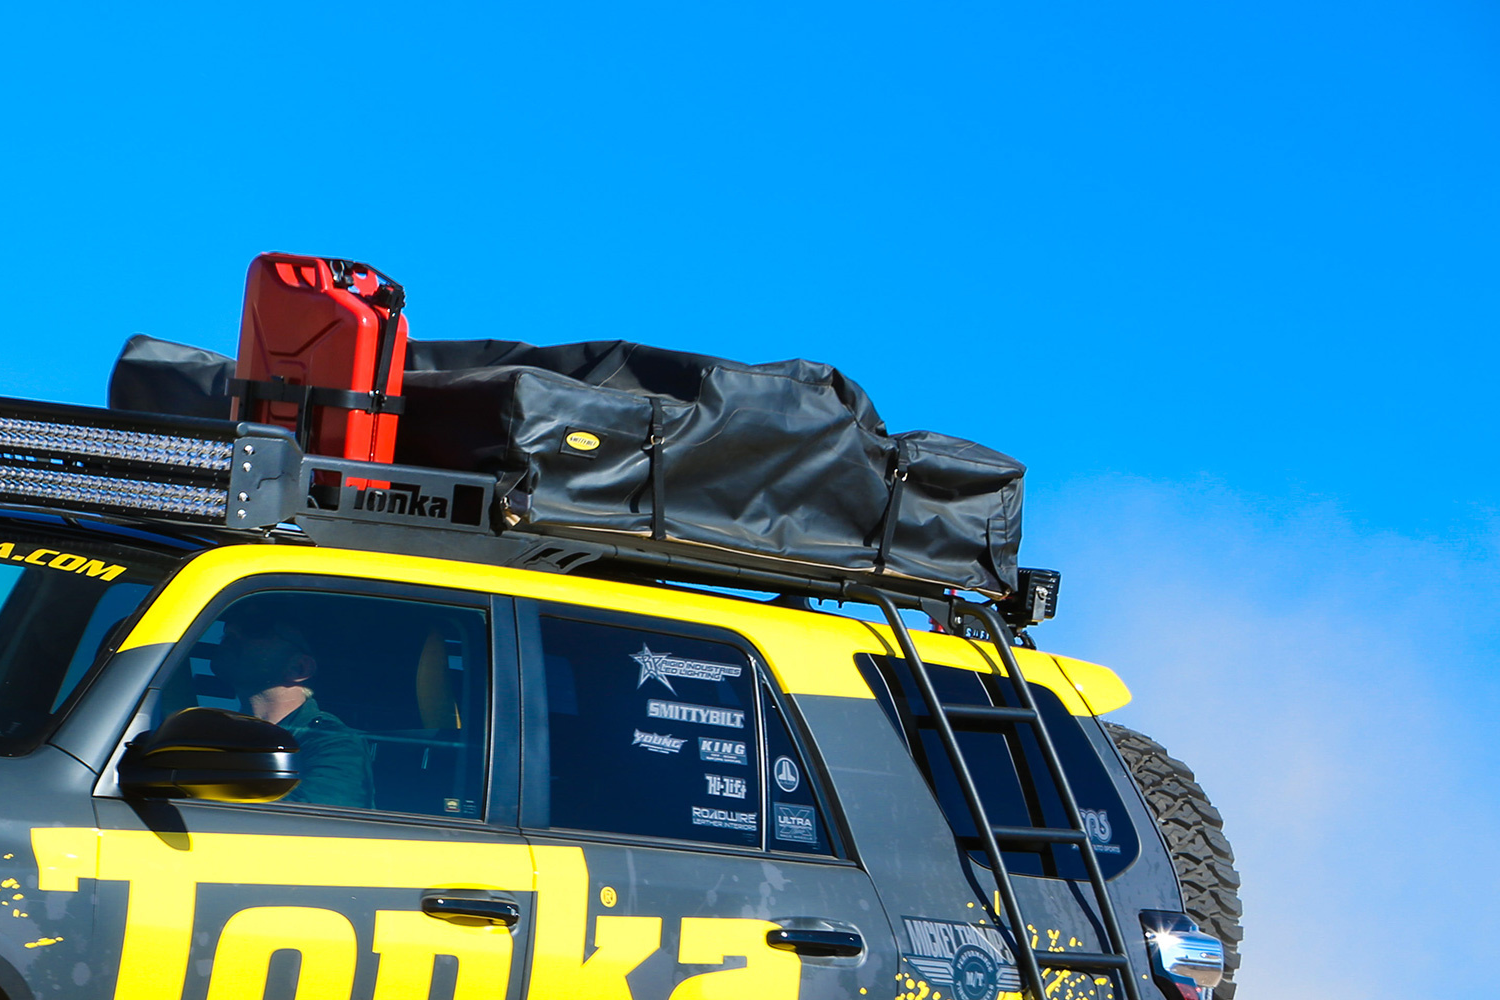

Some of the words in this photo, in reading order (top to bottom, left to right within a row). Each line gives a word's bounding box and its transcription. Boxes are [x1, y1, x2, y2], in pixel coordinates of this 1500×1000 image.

[345, 477, 449, 519] Tonka
[679, 670, 721, 680] LIGHTING
[685, 662, 741, 676] INDUSTRIES
[648, 702, 744, 727] SMITTYBILT
[701, 741, 745, 755] KING
[705, 775, 747, 799] Hi-Lift
[692, 807, 757, 824] ROADWIRE
[778, 815, 812, 827] ULTRA
[904, 919, 958, 959] MICKEY
